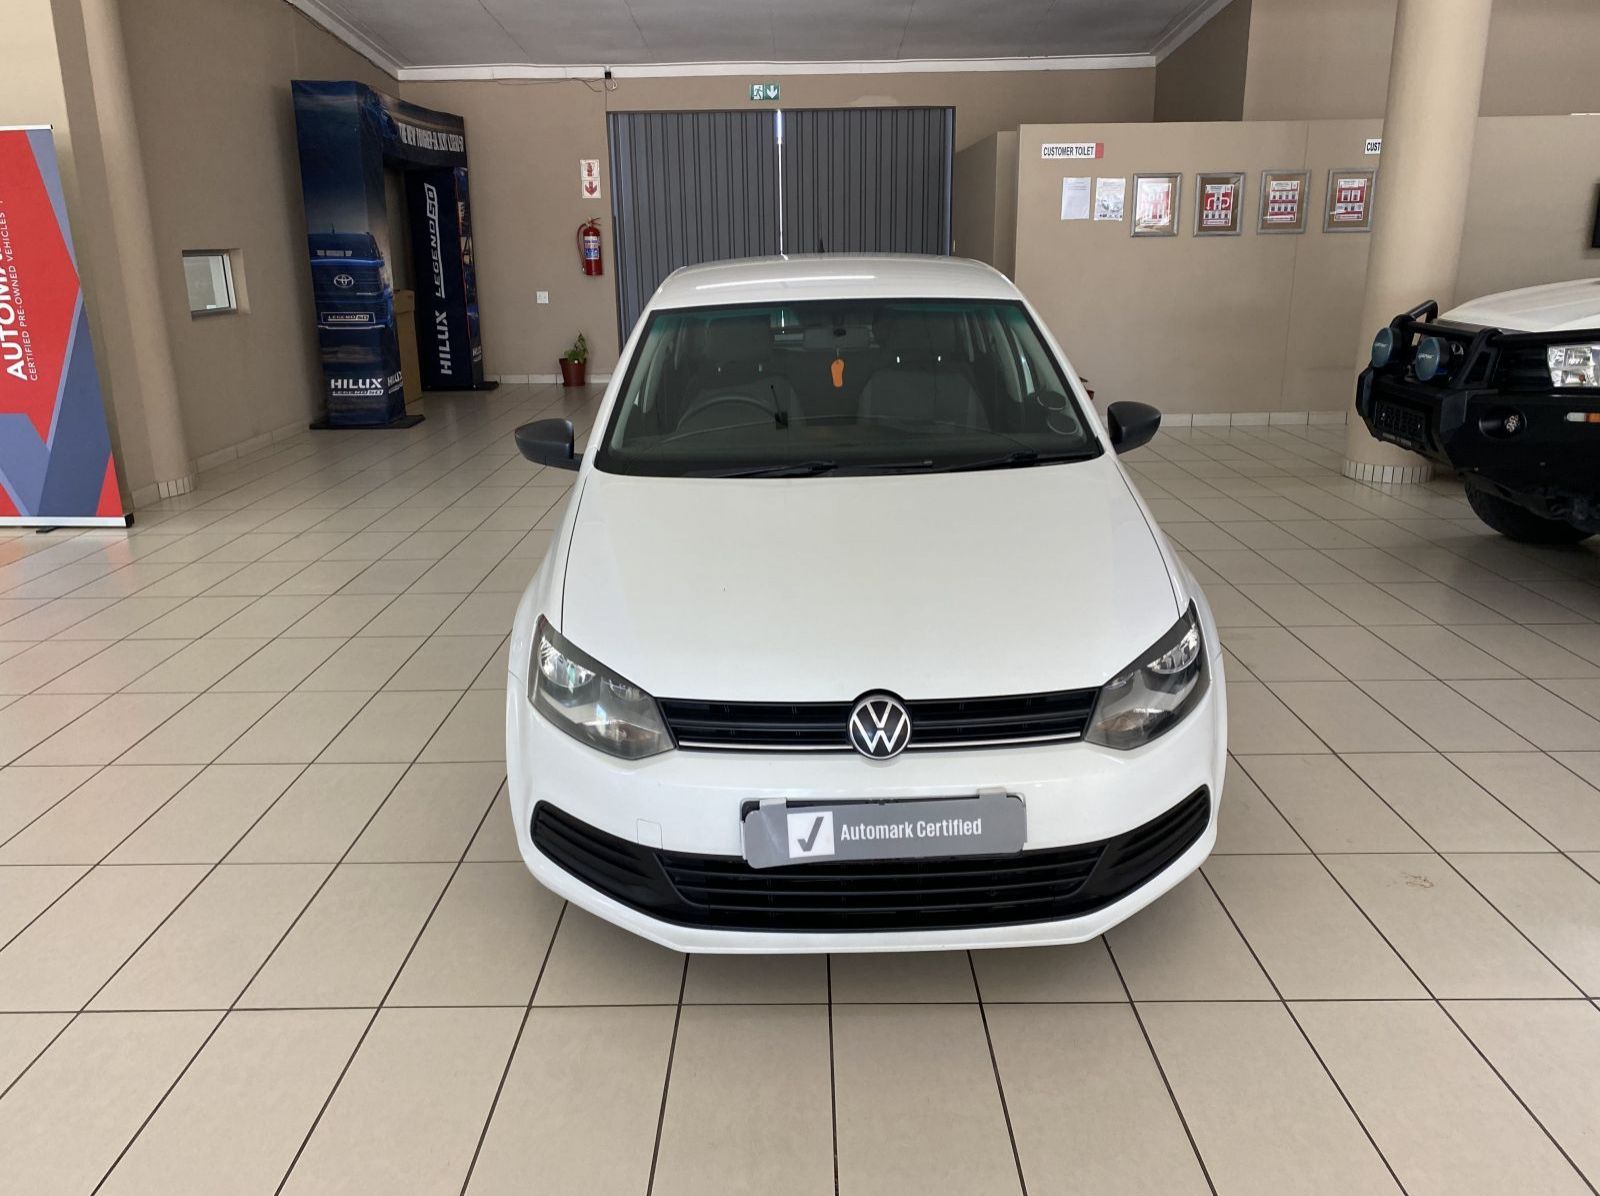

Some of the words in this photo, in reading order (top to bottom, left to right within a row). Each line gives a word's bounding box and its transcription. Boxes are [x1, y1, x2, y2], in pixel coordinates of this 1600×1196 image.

[1043, 146, 1074, 156] CUSTOMER
[1075, 146, 1094, 156] TOILET
[1367, 142, 1381, 152] CUST
[0, 212, 14, 262] VEHICLES
[9, 265, 27, 327] PRE-OWNED
[22, 330, 38, 381] CERTIFIED
[435, 310, 452, 375] HILUX
[331, 378, 383, 389] HILUX
[840, 820, 914, 841] Automark
[916, 818, 982, 838] Certified
